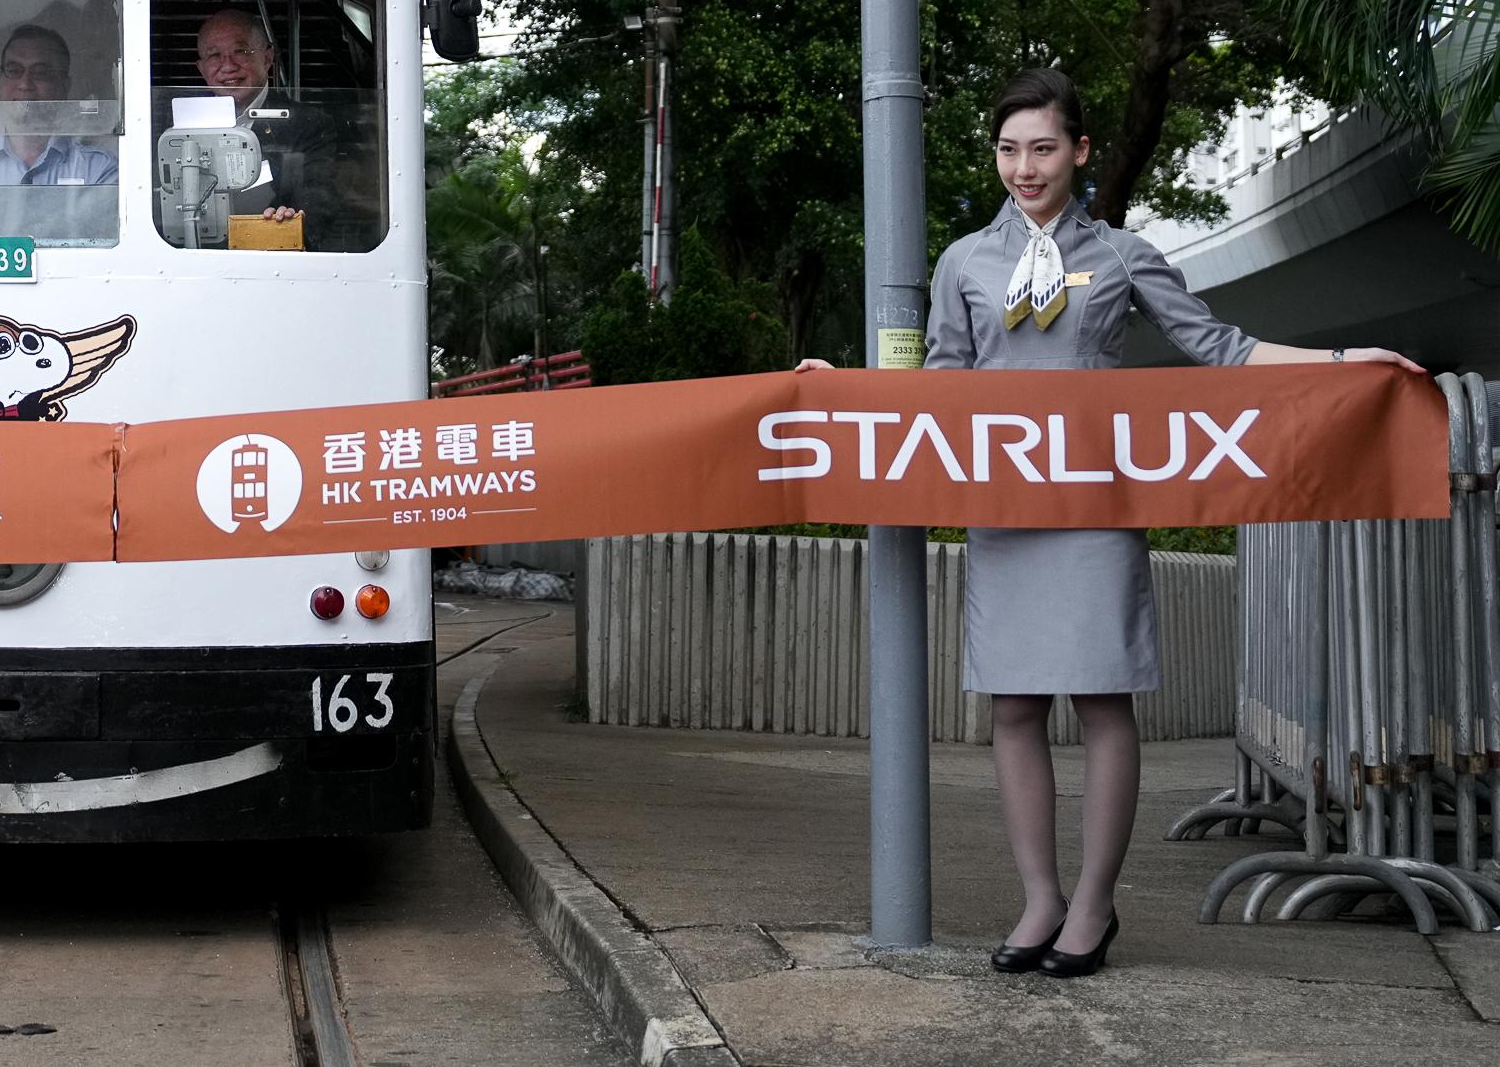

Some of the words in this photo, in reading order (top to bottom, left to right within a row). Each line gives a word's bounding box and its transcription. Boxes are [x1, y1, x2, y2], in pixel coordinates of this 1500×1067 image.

[893, 346, 913, 355] 2333
[322, 420, 536, 475] 香港電車
[757, 408, 1268, 483] STARLUX
[322, 481, 361, 505] HK
[370, 469, 537, 502] TRAMWAYS
[393, 510, 426, 524] EST.
[430, 506, 467, 522] 1904
[311, 672, 394, 732] 163
